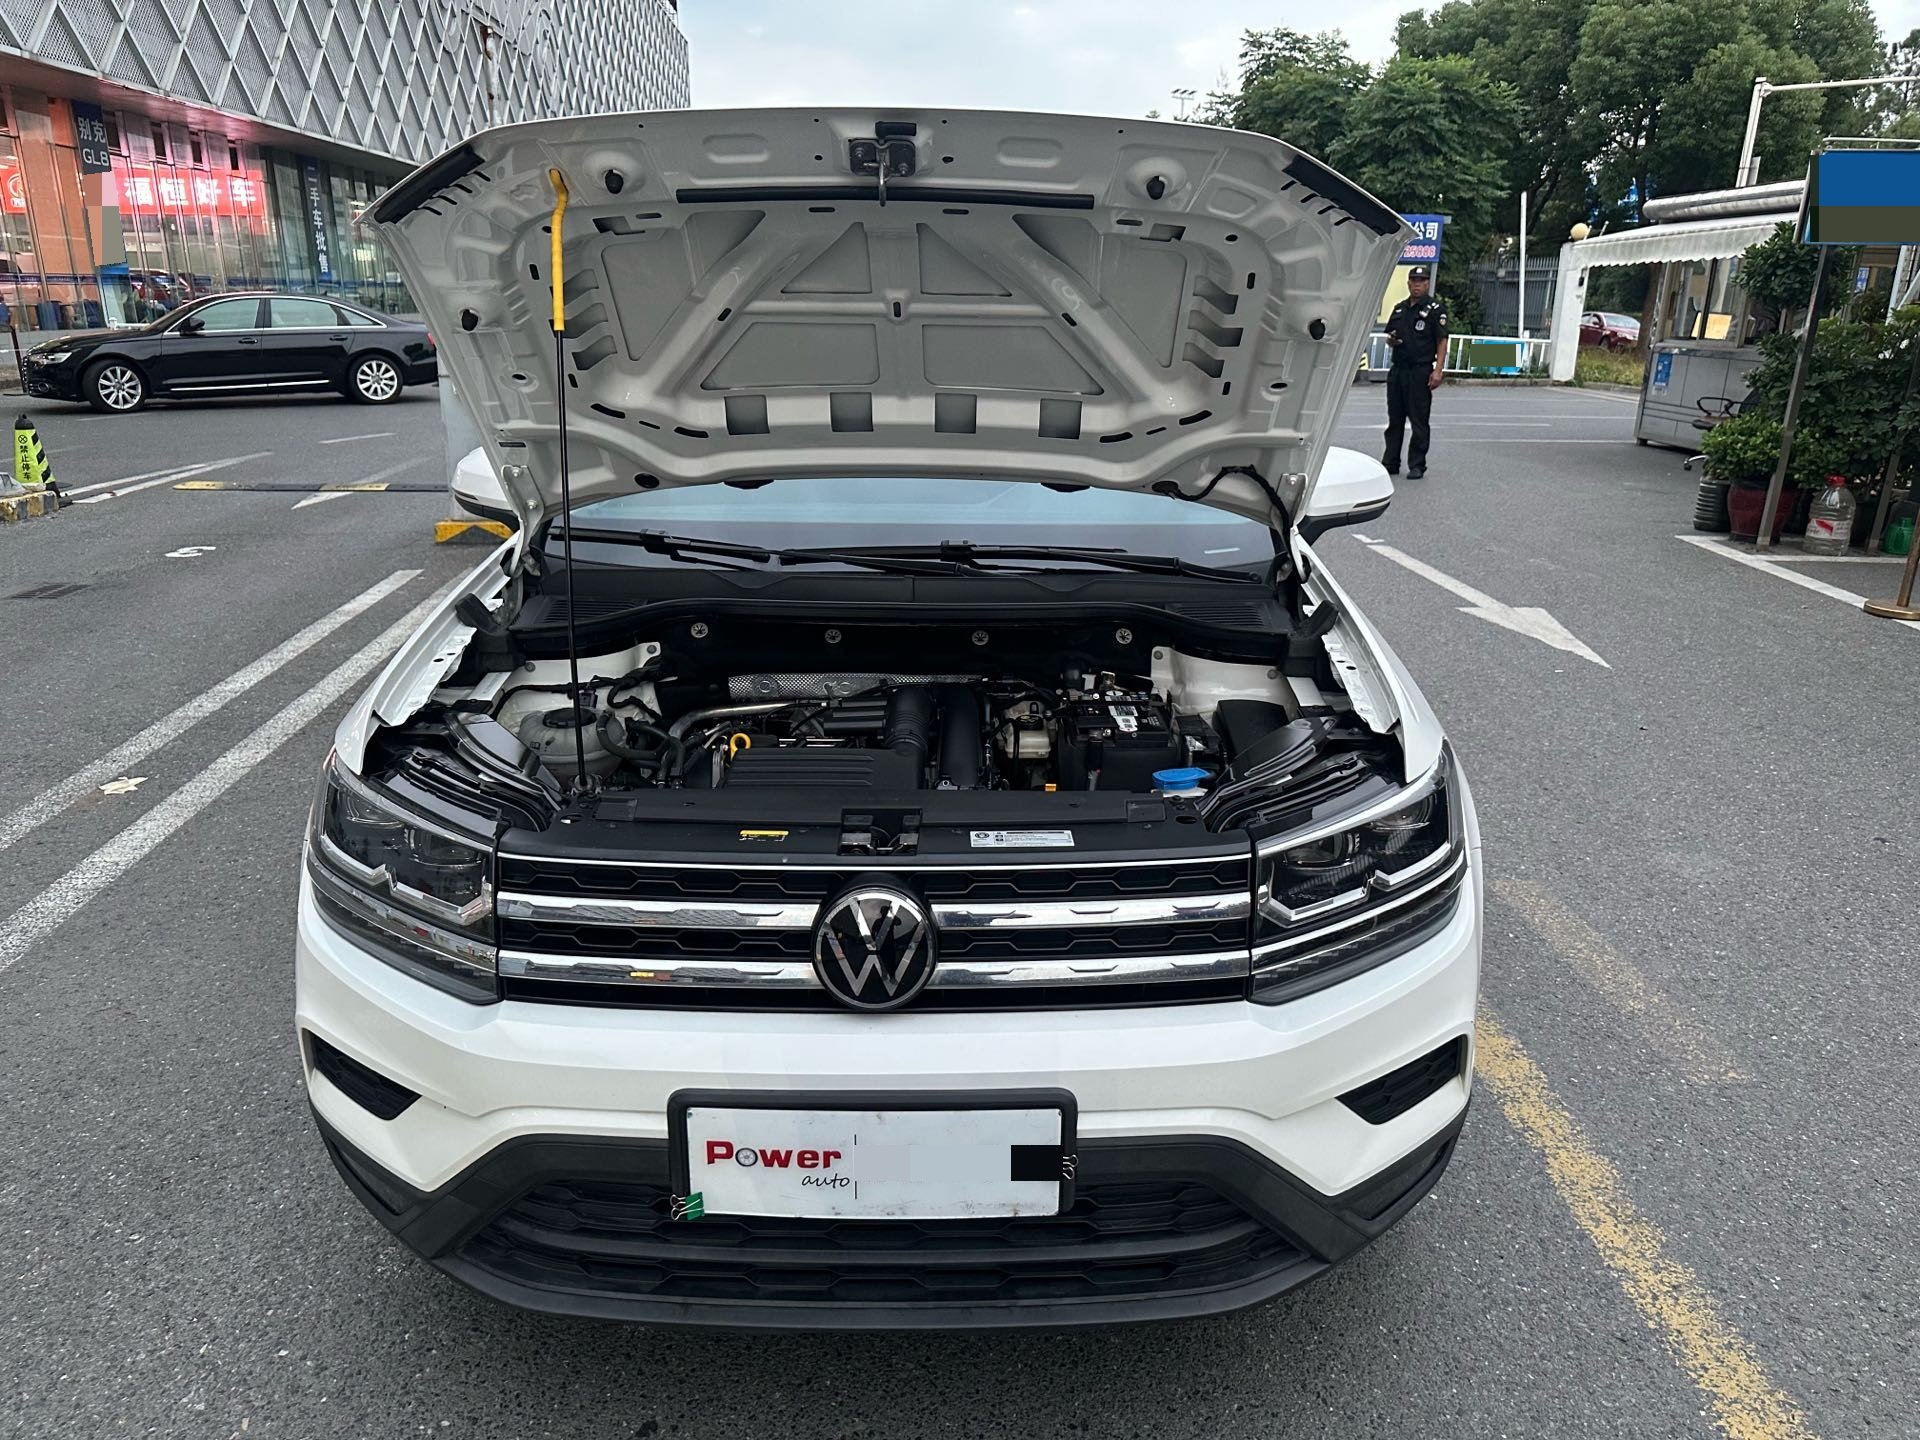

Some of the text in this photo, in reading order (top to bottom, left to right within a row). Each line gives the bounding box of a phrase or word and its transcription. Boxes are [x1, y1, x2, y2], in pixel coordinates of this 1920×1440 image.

[78, 116, 106, 143] 别克
[82, 148, 110, 166] GL8
[20, 445, 32, 480] 禁止停车
[706, 1140, 842, 1169] Power
[801, 1173, 851, 1189] auto
